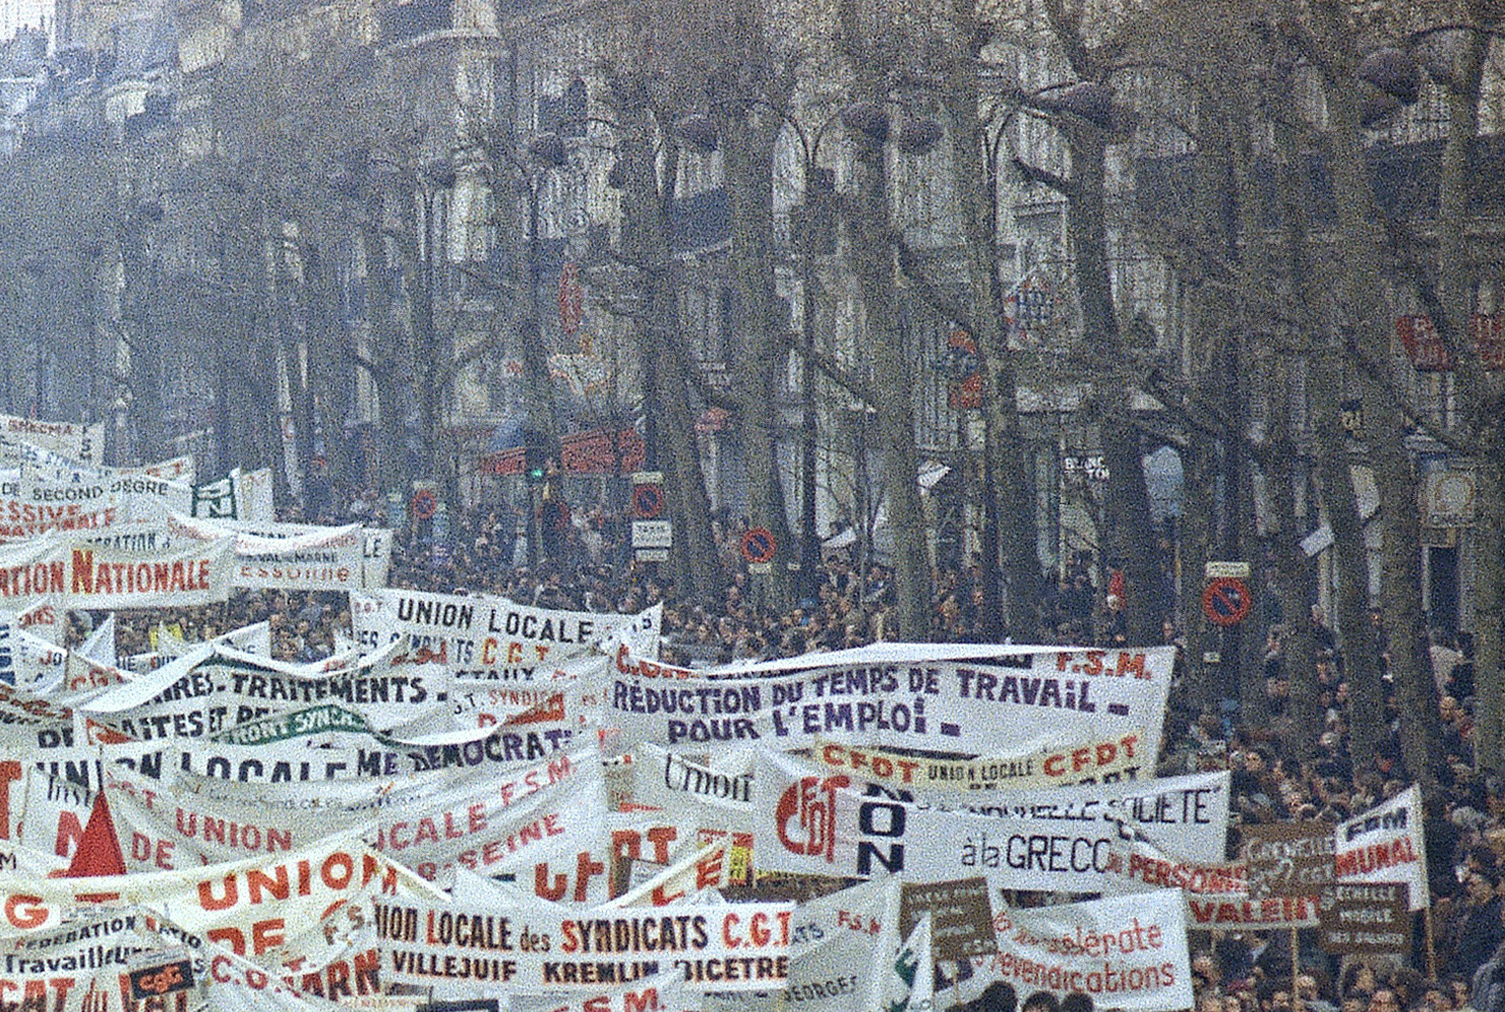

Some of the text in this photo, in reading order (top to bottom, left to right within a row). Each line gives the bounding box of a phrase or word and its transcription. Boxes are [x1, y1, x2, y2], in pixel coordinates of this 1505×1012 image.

[33, 486, 104, 501] SECOND
[72, 549, 211, 595] NATIONALE
[397, 598, 594, 645] UNION LOCALE
[771, 681, 804, 706] DU
[811, 666, 899, 700] TEMPS
[908, 667, 941, 696] DE
[667, 717, 759, 745] POUR
[822, 743, 921, 786] CFDT
[926, 762, 979, 784] UNION
[981, 757, 1034, 780] LOCALE
[1042, 735, 1140, 779] CFDT
[175, 805, 293, 853] UNION
[426, 910, 514, 952] LOCALE
[519, 922, 551, 953] des
[560, 914, 708, 953] SYNDICATS
[392, 949, 517, 983] VILLEJUIF
[542, 958, 659, 986] KREMLIN
